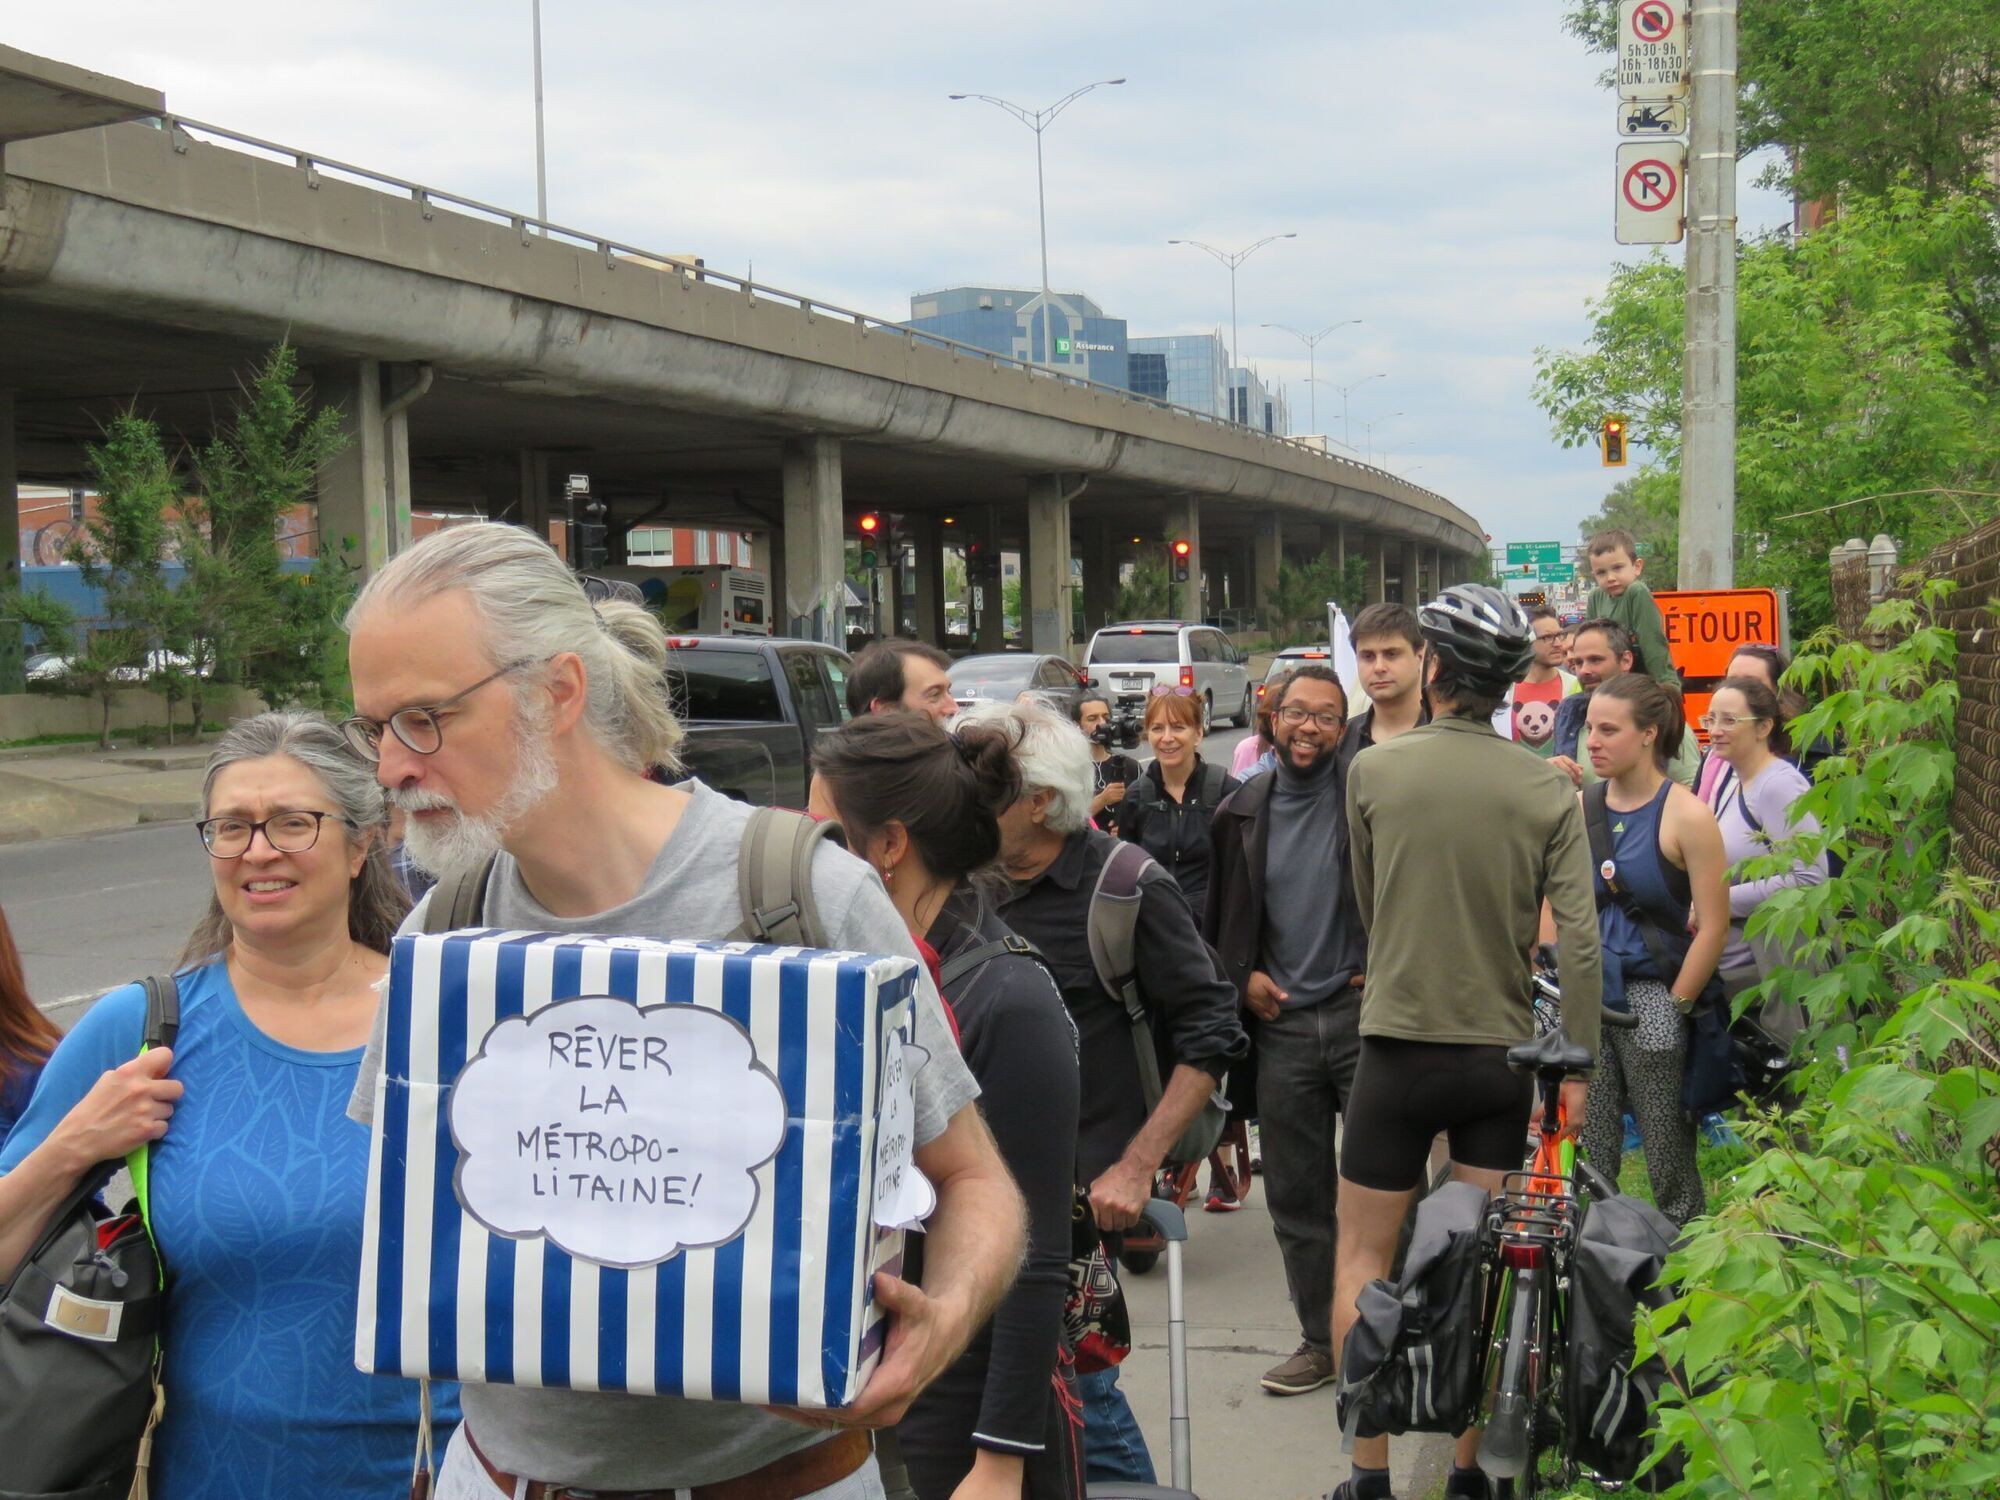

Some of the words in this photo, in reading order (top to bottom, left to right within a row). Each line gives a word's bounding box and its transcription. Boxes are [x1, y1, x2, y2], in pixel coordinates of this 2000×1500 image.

[1627, 42, 1676, 57] 5h30-9h
[1622, 56, 1682, 71] 16h-18h30
[1059, 340, 1070, 351] TD
[1076, 342, 1115, 352] Assurance
[1664, 606, 1763, 644] ÉTOUR
[548, 1024, 673, 1077] RÊVER
[579, 1084, 628, 1115] LA
[890, 1098, 898, 1120] LA
[517, 1122, 680, 1166] MÉTROPO-
